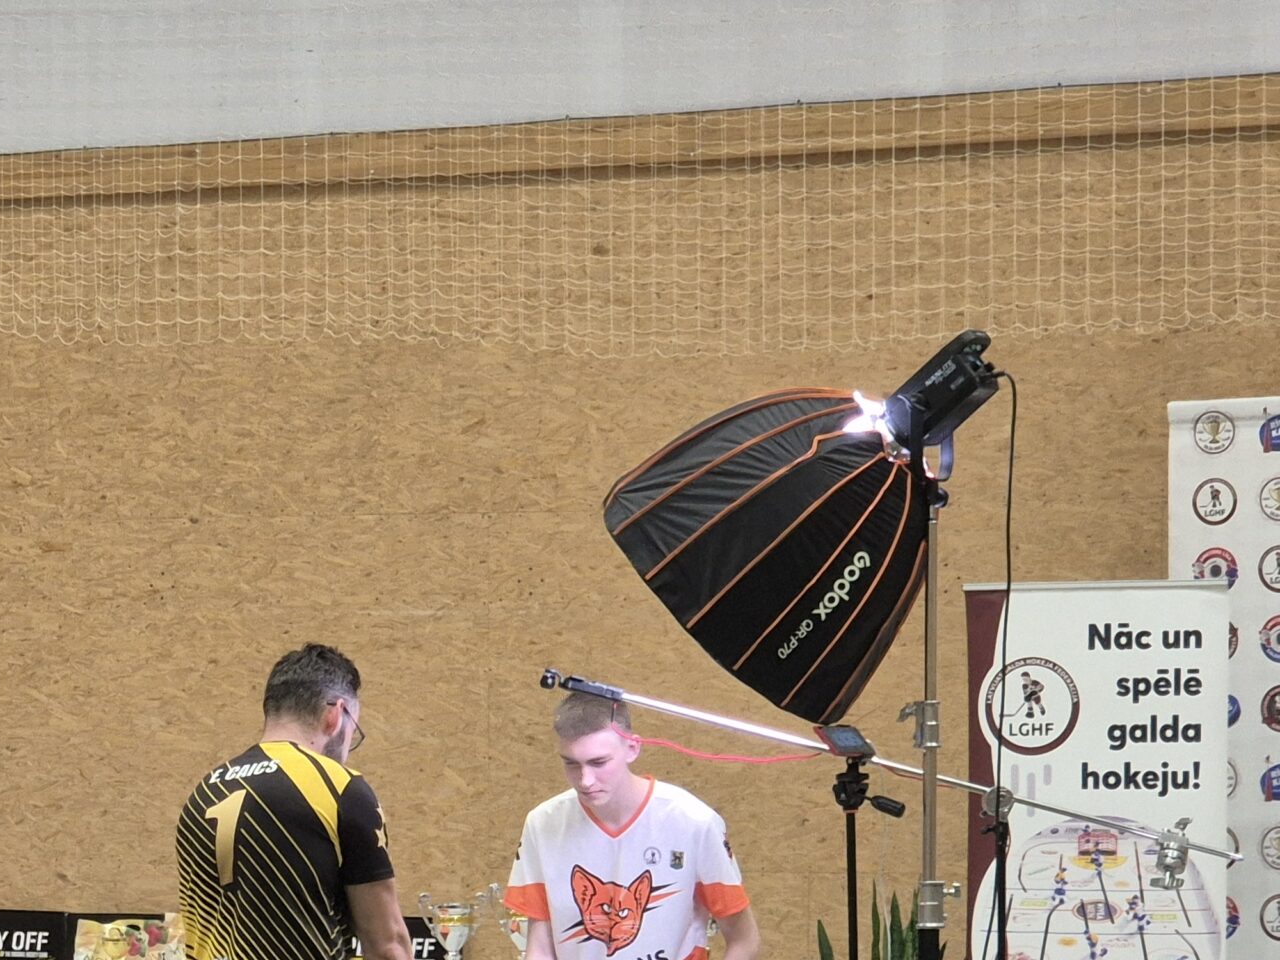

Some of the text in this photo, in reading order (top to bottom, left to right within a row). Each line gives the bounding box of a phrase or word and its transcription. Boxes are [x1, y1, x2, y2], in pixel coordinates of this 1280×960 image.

[811, 551, 871, 621] Godox
[777, 619, 814, 660] QR-P70
[1088, 623, 1203, 650] Nāc un
[1002, 660, 1025, 675] ALDA
[1116, 668, 1203, 704] spēlē
[1009, 722, 1054, 737] LGHF
[1107, 714, 1202, 751] galda
[1081, 761, 1201, 798] hokeju!
[204, 788, 248, 887] 1
[11, 931, 50, 951] OFF
[412, 937, 437, 959] FF
